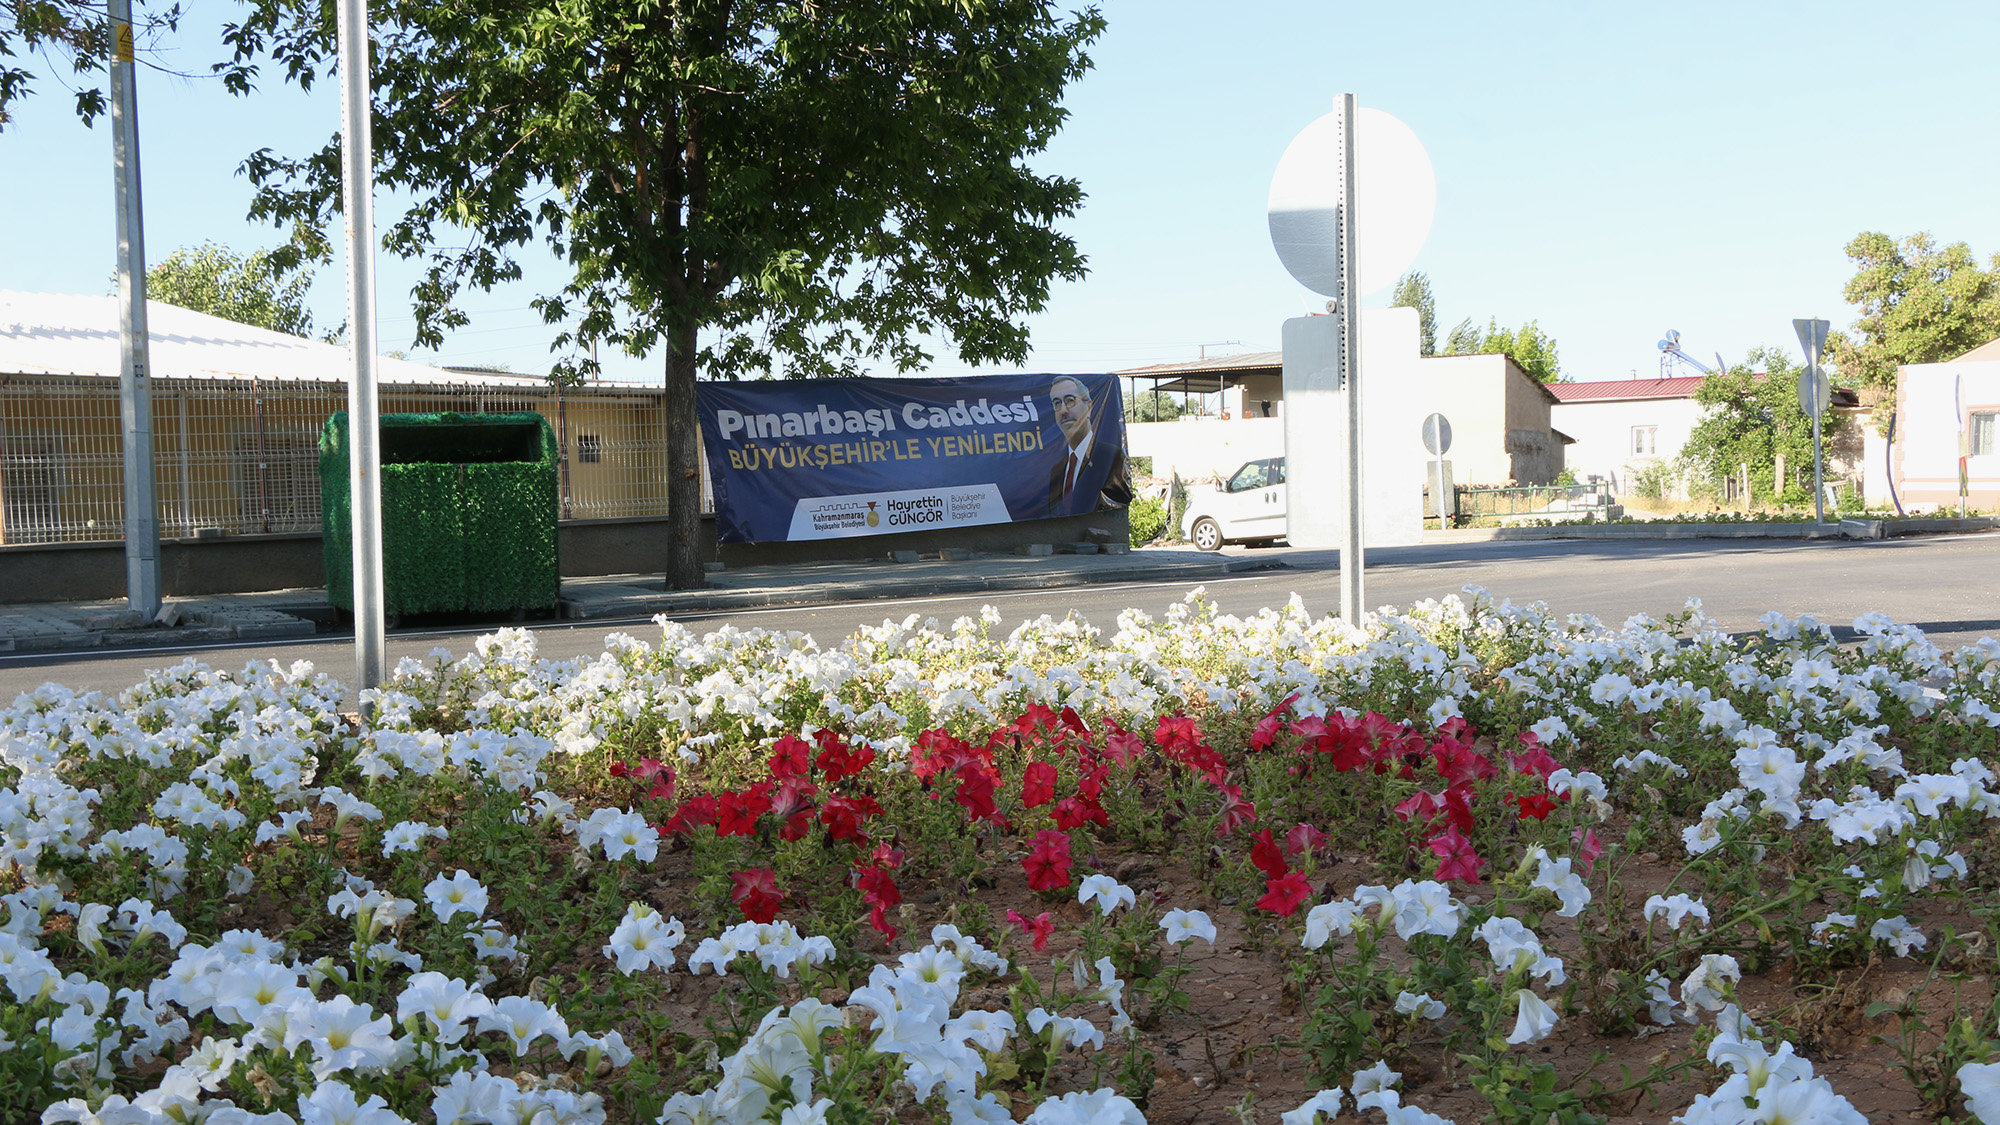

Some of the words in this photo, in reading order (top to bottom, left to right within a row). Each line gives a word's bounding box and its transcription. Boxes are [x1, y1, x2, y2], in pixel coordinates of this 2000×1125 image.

[717, 404, 896, 440] Pınarbaşı
[902, 395, 1038, 429] Caddesi
[926, 425, 1044, 458] YENİLENDİ
[887, 495, 943, 513] Hayrettin
[951, 493, 986, 504] Büyükşehir
[951, 502, 981, 512] Belediye
[812, 511, 865, 522] Kahramanmaraş
[888, 509, 943, 526] GÜNGÖR
[952, 511, 978, 521] Başkanı
[814, 522, 840, 531] Büyükşehir
[841, 520, 866, 530] Belediyesi
